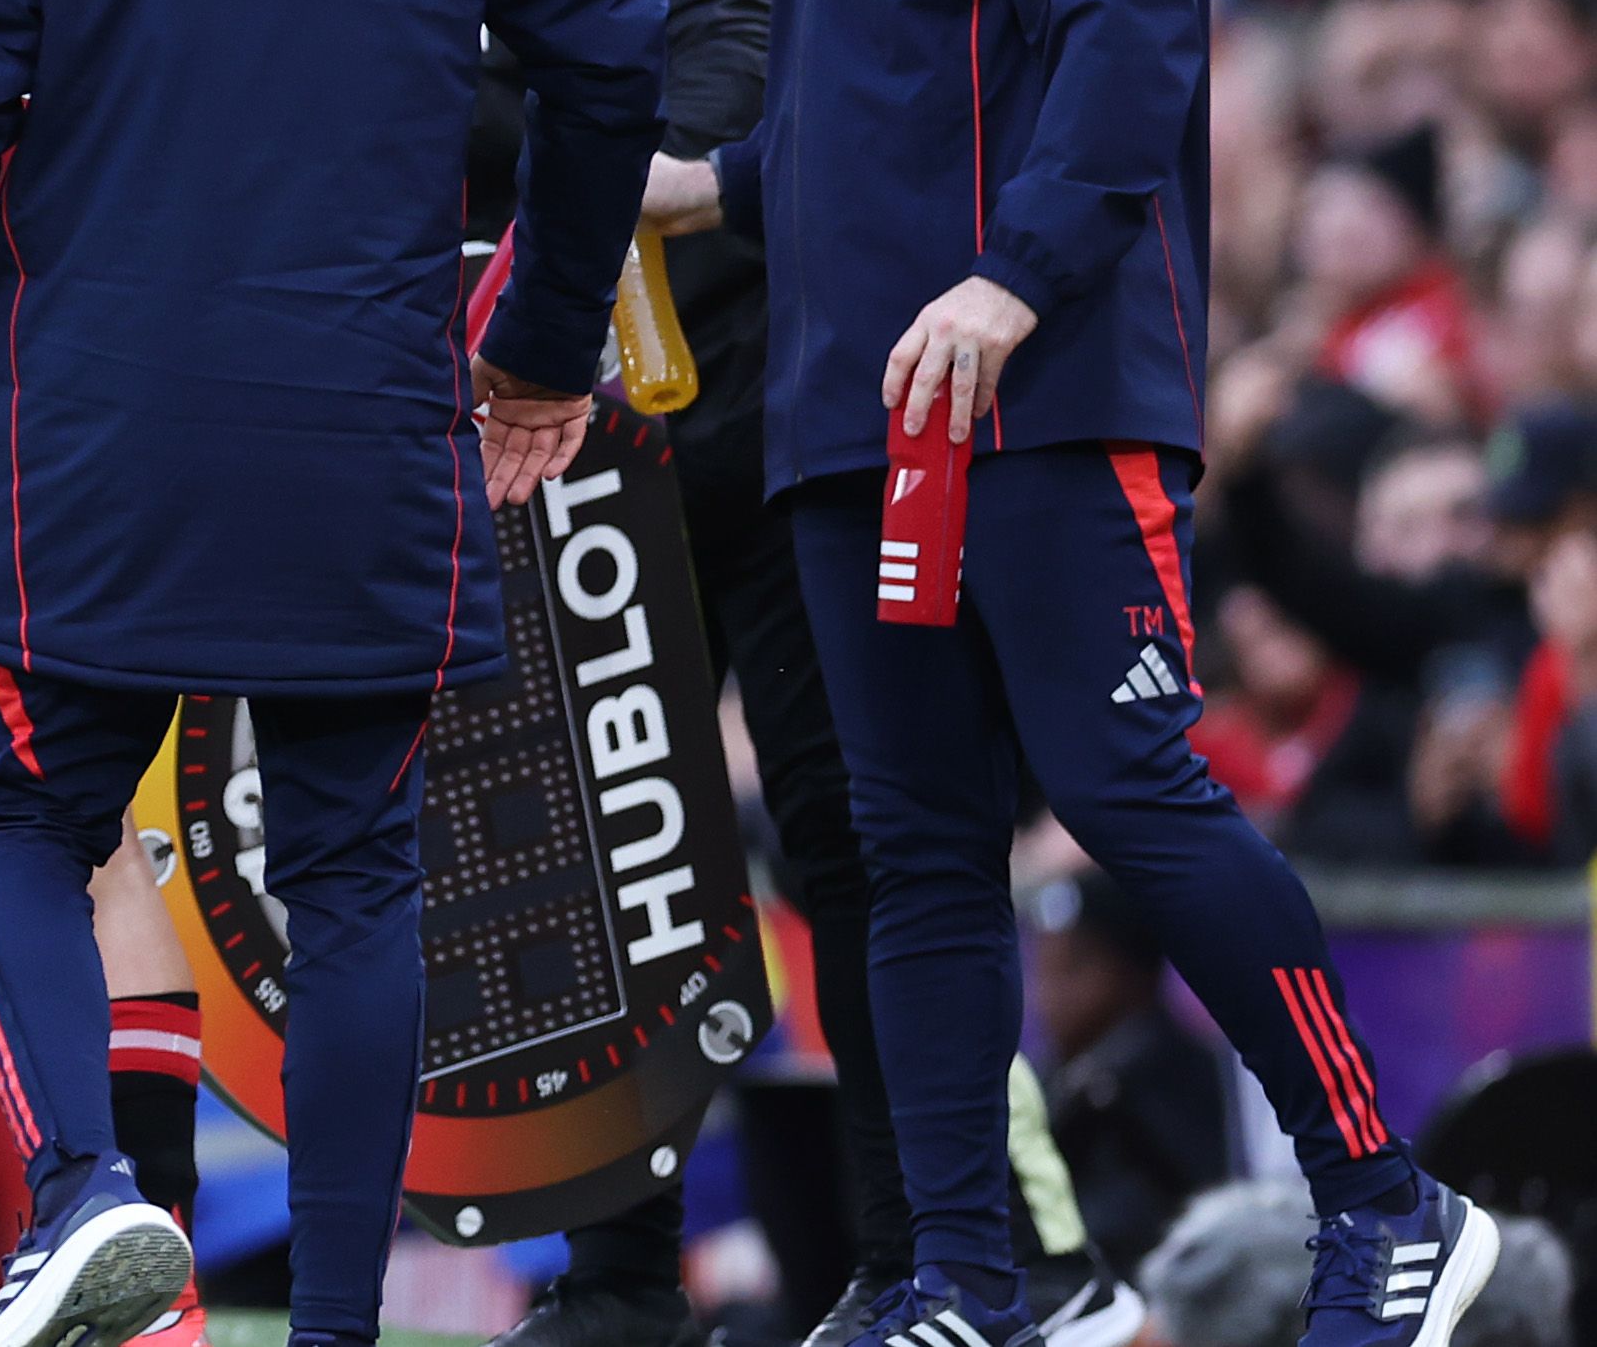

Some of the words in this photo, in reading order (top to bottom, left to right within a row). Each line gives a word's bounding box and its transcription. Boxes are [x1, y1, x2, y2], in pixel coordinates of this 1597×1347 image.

[1122, 605, 1165, 637] TM
[542, 468, 705, 966] HUBLOT
[535, 1069, 569, 1098] 45
